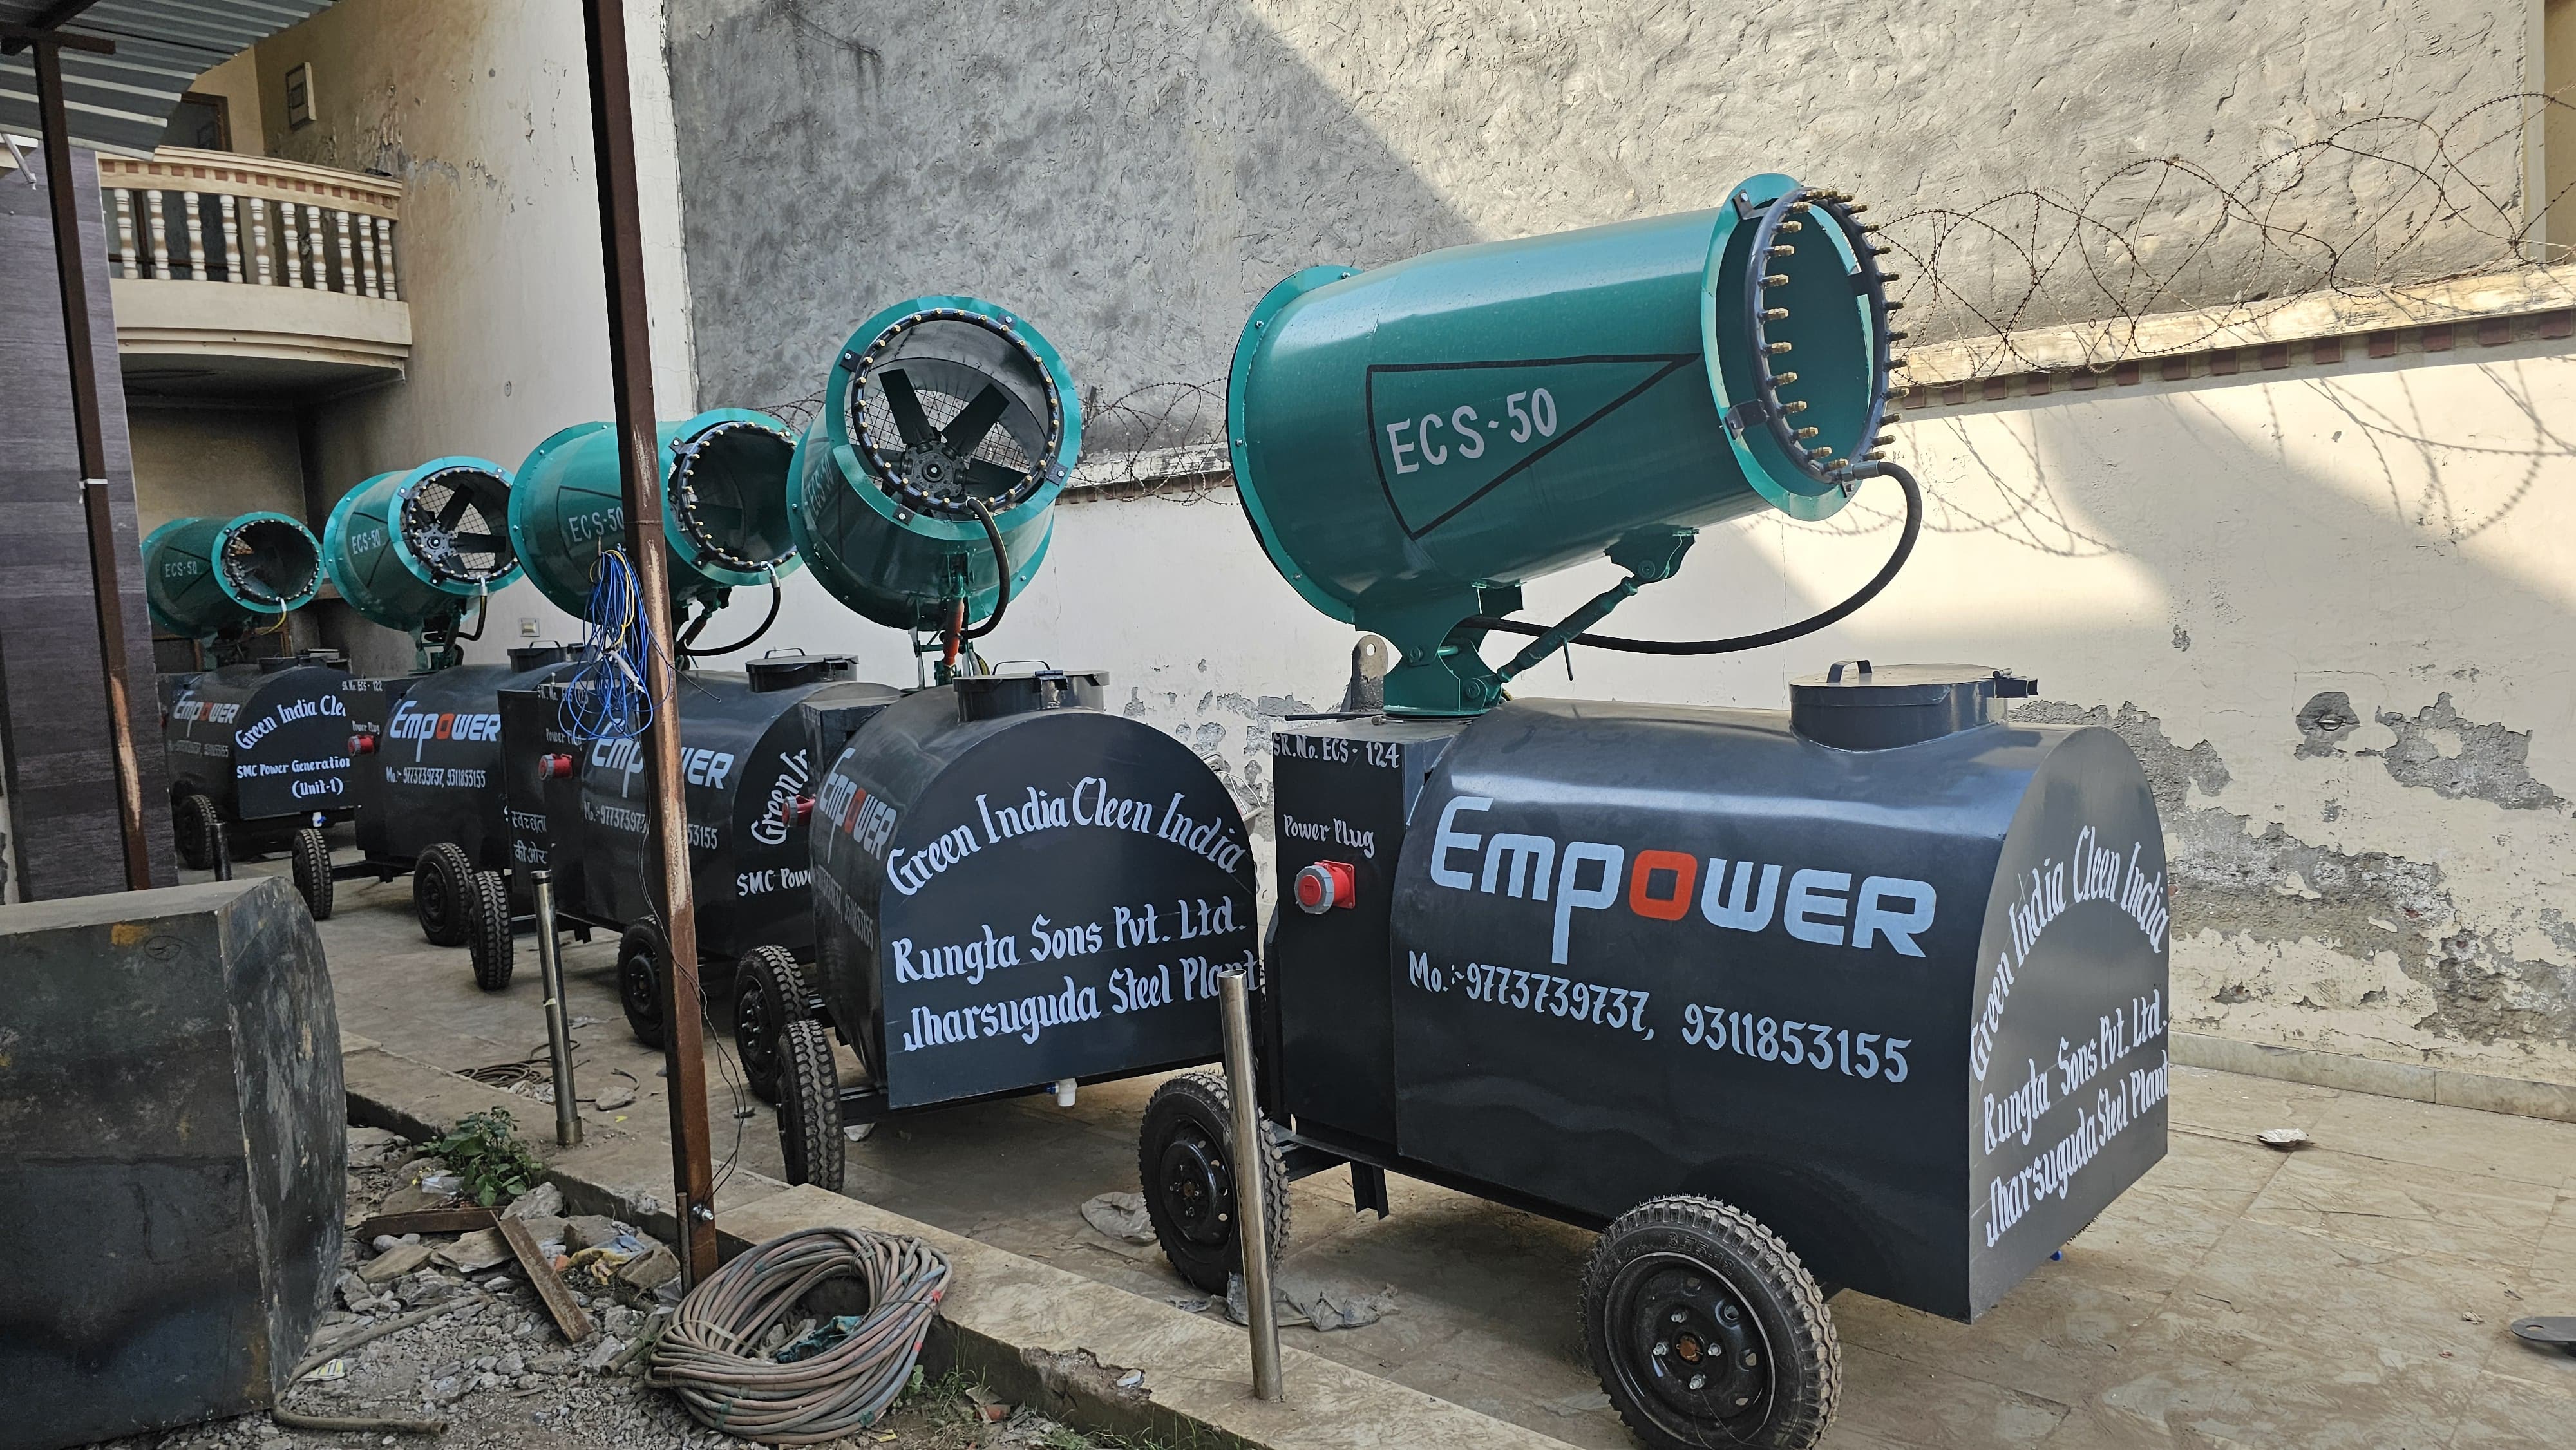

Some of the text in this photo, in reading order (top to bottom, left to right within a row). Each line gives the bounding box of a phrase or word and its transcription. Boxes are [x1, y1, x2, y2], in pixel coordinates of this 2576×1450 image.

[235, 695, 346, 749] Green India Cle
[1366, 742, 1400, 768] 124
[236, 765, 258, 778] SMC
[260, 764, 289, 777] Power
[887, 825, 982, 896] Green
[975, 786, 1071, 844] India
[1072, 777, 1153, 834] Cleen
[1157, 792, 1247, 874] India
[1283, 814, 1375, 860] Power Plug
[736, 868, 811, 896] SMC Pow
[892, 896, 1247, 985] Rungta Sons Pvt. Ltd.
[1970, 825, 2169, 1082] Green India Cleen India
[903, 949, 1260, 1051] Jharsuguda Steel Plat
[1681, 1003, 1912, 1083] 9311853155
[1984, 988, 2168, 1155] Rungta Sons Pvt. Ltd.
[1986, 1050, 2169, 1248] Jharsuguda Steel Plant
